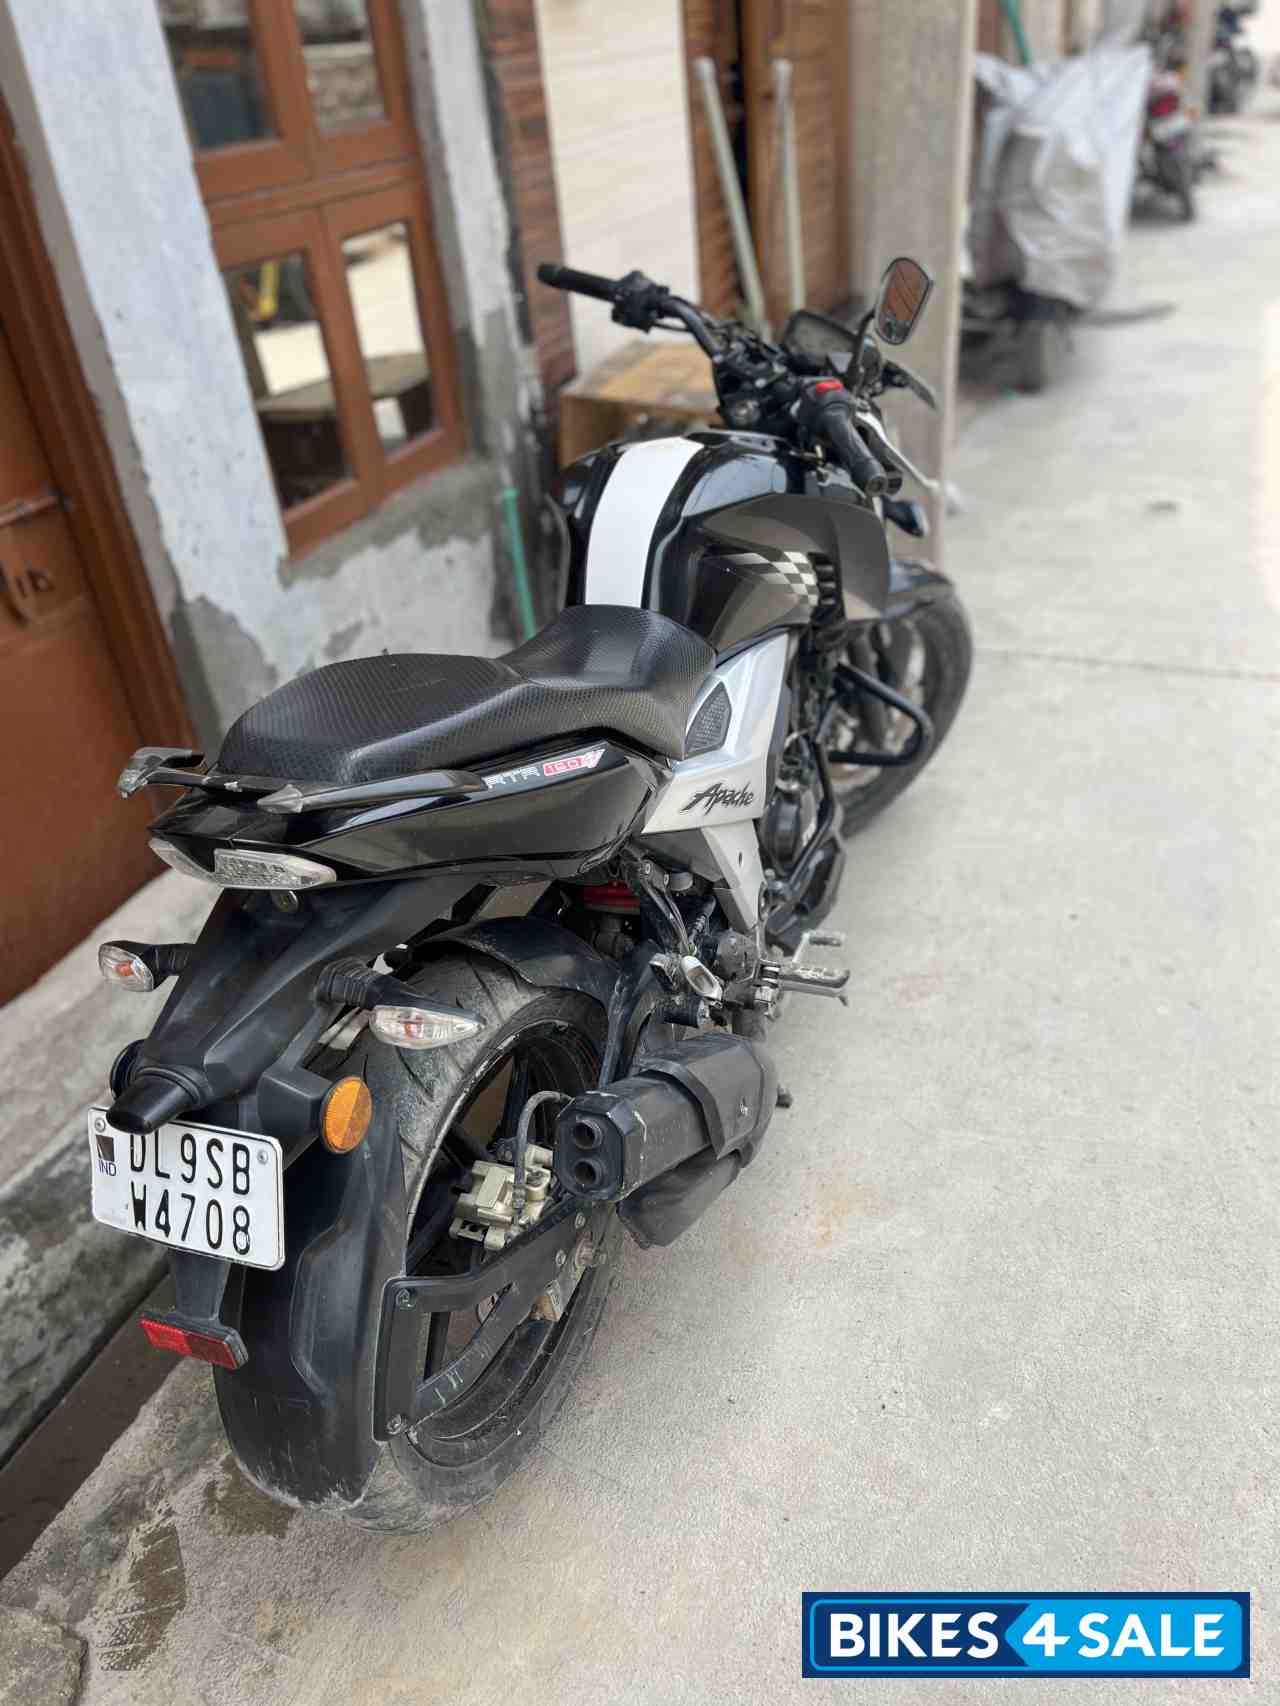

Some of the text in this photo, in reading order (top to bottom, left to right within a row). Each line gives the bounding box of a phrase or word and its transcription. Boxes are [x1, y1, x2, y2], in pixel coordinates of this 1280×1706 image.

[679, 781, 754, 816] Apache
[98, 1160, 117, 1177] IND
[130, 1128, 251, 1195] DL9SB
[130, 1181, 251, 1255] W4708
